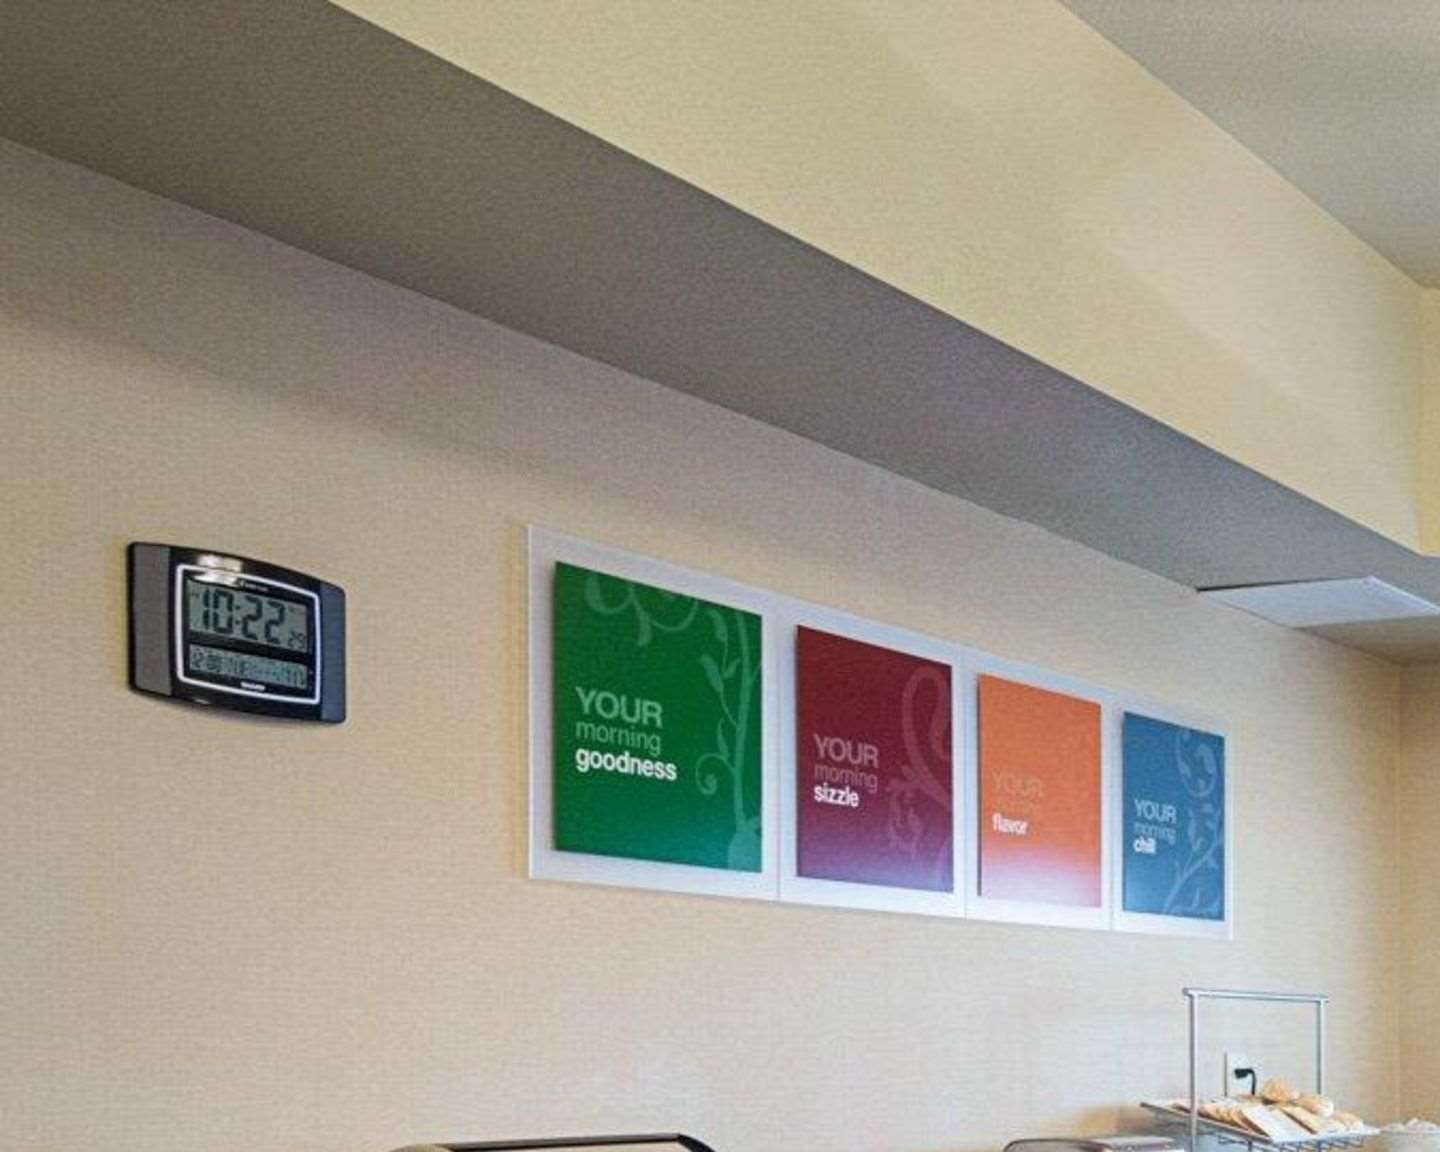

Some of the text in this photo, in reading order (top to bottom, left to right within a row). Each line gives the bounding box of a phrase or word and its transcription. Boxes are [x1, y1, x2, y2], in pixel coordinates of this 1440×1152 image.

[203, 589, 285, 644] 10:22
[575, 686, 663, 729] YOUR
[575, 721, 662, 757] morning
[814, 734, 879, 769] YOUR
[575, 747, 678, 781] goodness
[814, 763, 878, 793] morning
[813, 782, 860, 808] sizzle
[1134, 799, 1177, 824] YOUR
[992, 812, 1029, 836] flavor
